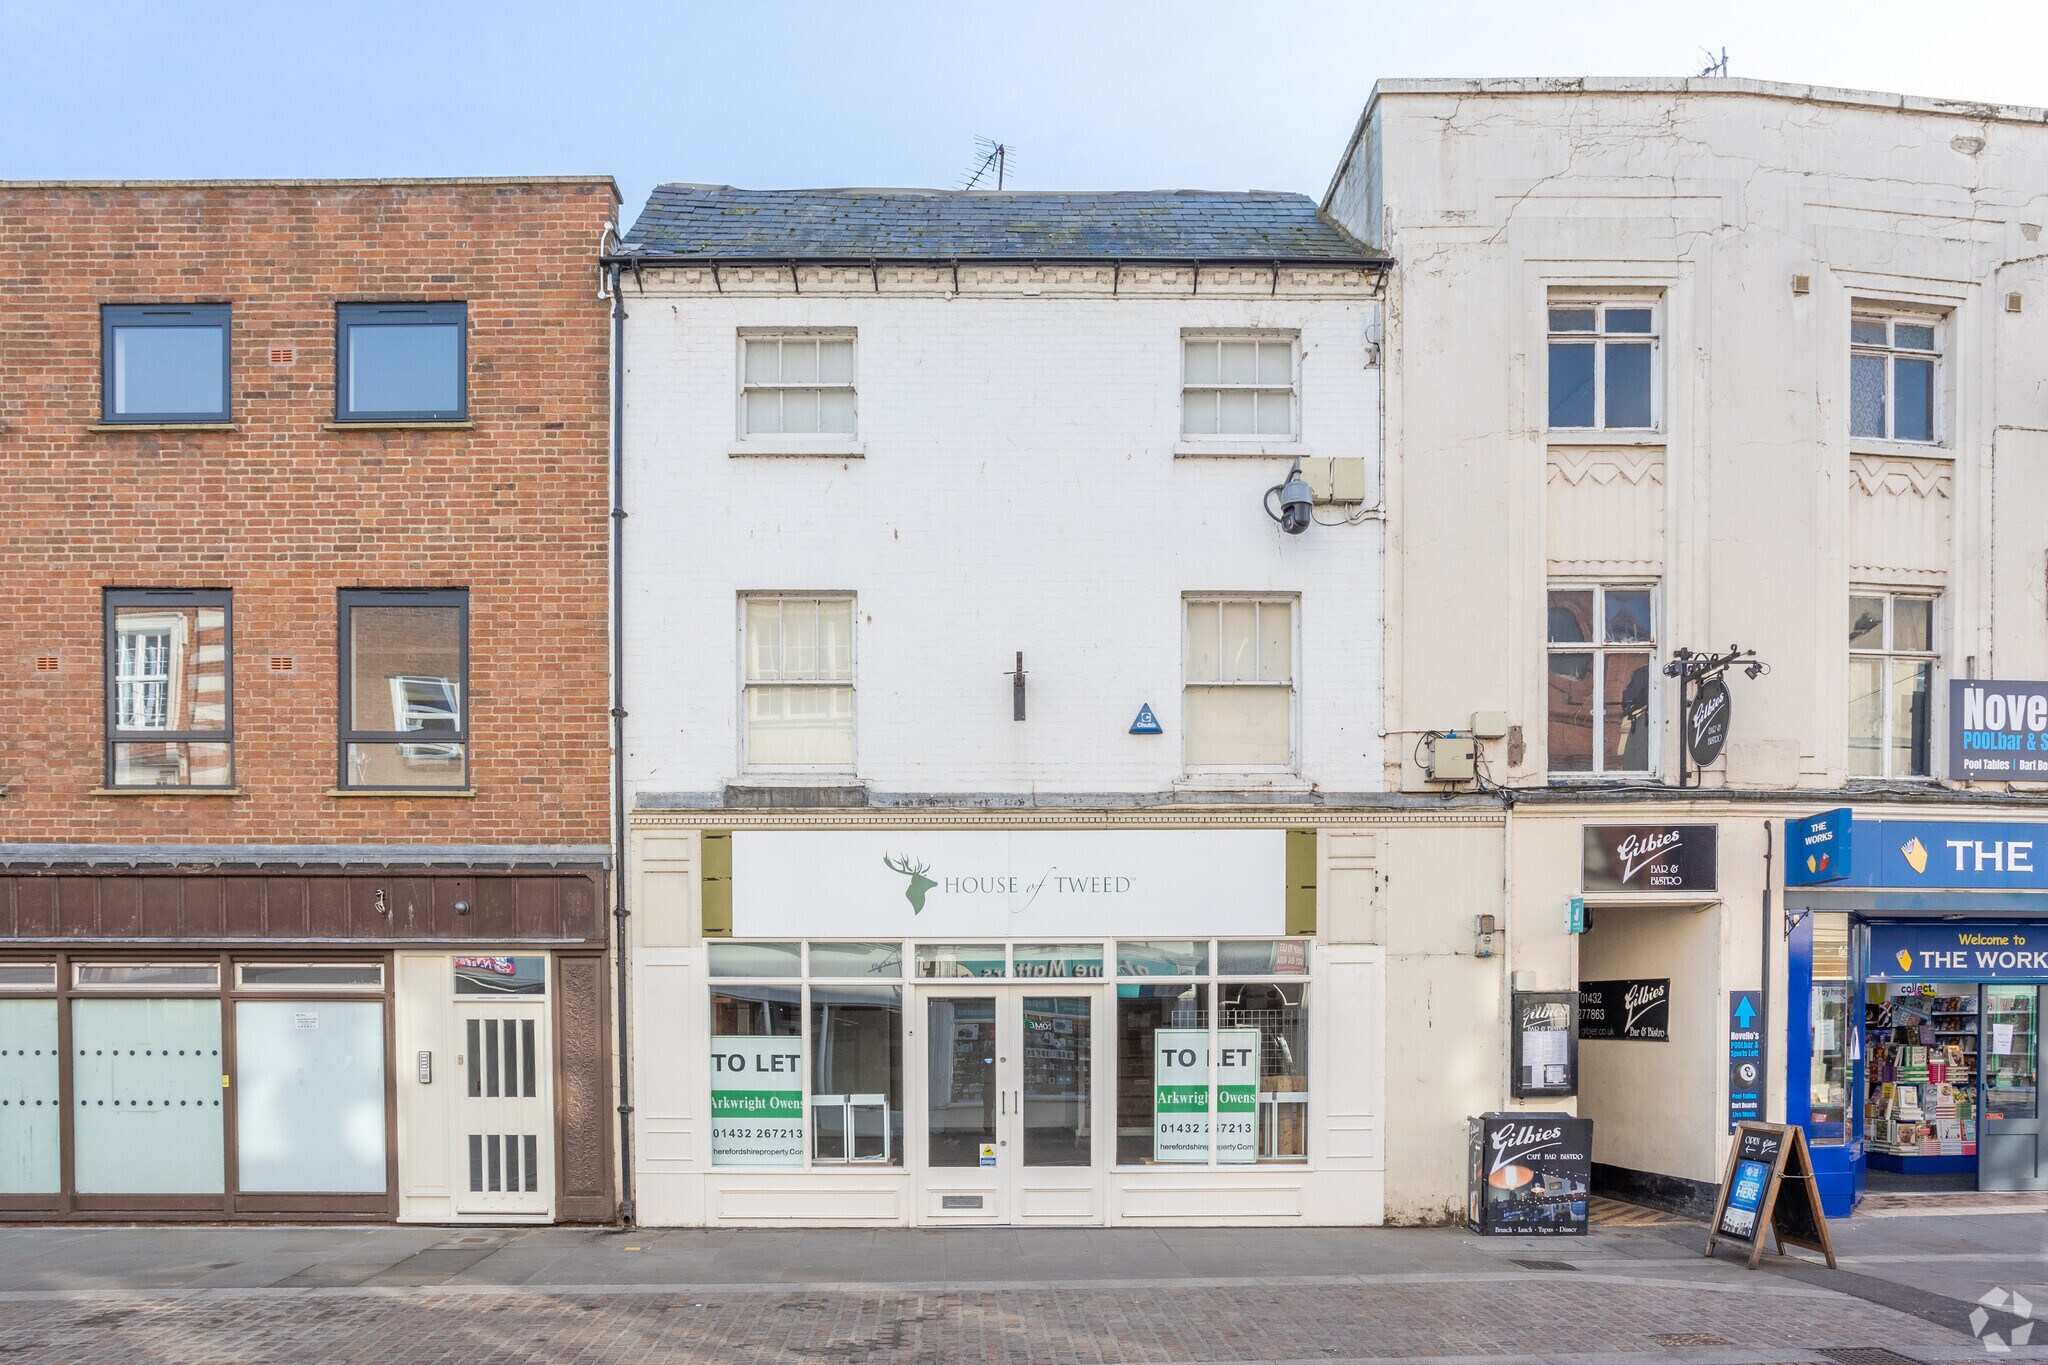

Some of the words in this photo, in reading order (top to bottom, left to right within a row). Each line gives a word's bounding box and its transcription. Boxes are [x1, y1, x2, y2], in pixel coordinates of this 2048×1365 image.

[1693, 692, 1725, 749] Gilbies
[1963, 731, 2023, 750] POOLbar
[2026, 732, 2037, 751] &
[1963, 758, 1982, 770] Pool
[1983, 759, 2010, 770] Tables
[2019, 759, 2036, 771] Dart
[1810, 821, 1827, 833] THE
[1804, 831, 1834, 846] WORKS
[1617, 830, 1683, 884] Gilbies
[1946, 839, 2034, 873] THE
[1650, 864, 1668, 874] BAR
[1670, 864, 1679, 874] &
[1650, 876, 1682, 886] BISTRO
[945, 876, 1018, 893] HOUSE
[1011, 866, 1057, 914] of
[1958, 933, 2009, 946] Welcome
[2013, 933, 2026, 946] to
[1919, 950, 1968, 969] THE
[1974, 951, 2048, 969] WORK
[1580, 992, 1603, 1004] 01432
[1624, 984, 1666, 1033] Gilbies
[1629, 1026, 1640, 1037] Bar
[1640, 1026, 1647, 1037] &
[1647, 1027, 1665, 1038] Bistro
[1730, 1031, 1760, 1041] Novello's
[1161, 1048, 1197, 1068] TO
[1730, 1050, 1748, 1058] Sports
[1748, 1049, 1759, 1057] Loft
[711, 1053, 746, 1073] TO
[756, 1053, 801, 1073] LET
[711, 1096, 766, 1111] Arkwright
[1219, 1090, 1256, 1104] Owens
[713, 1128, 752, 1139] 01432
[756, 1128, 803, 1139] 267213
[1160, 1123, 1200, 1133] 01432
[1490, 1123, 1563, 1176] Gilbies
[1735, 1185, 1759, 1201] HERE
[1537, 1226, 1554, 1234] Tapas
